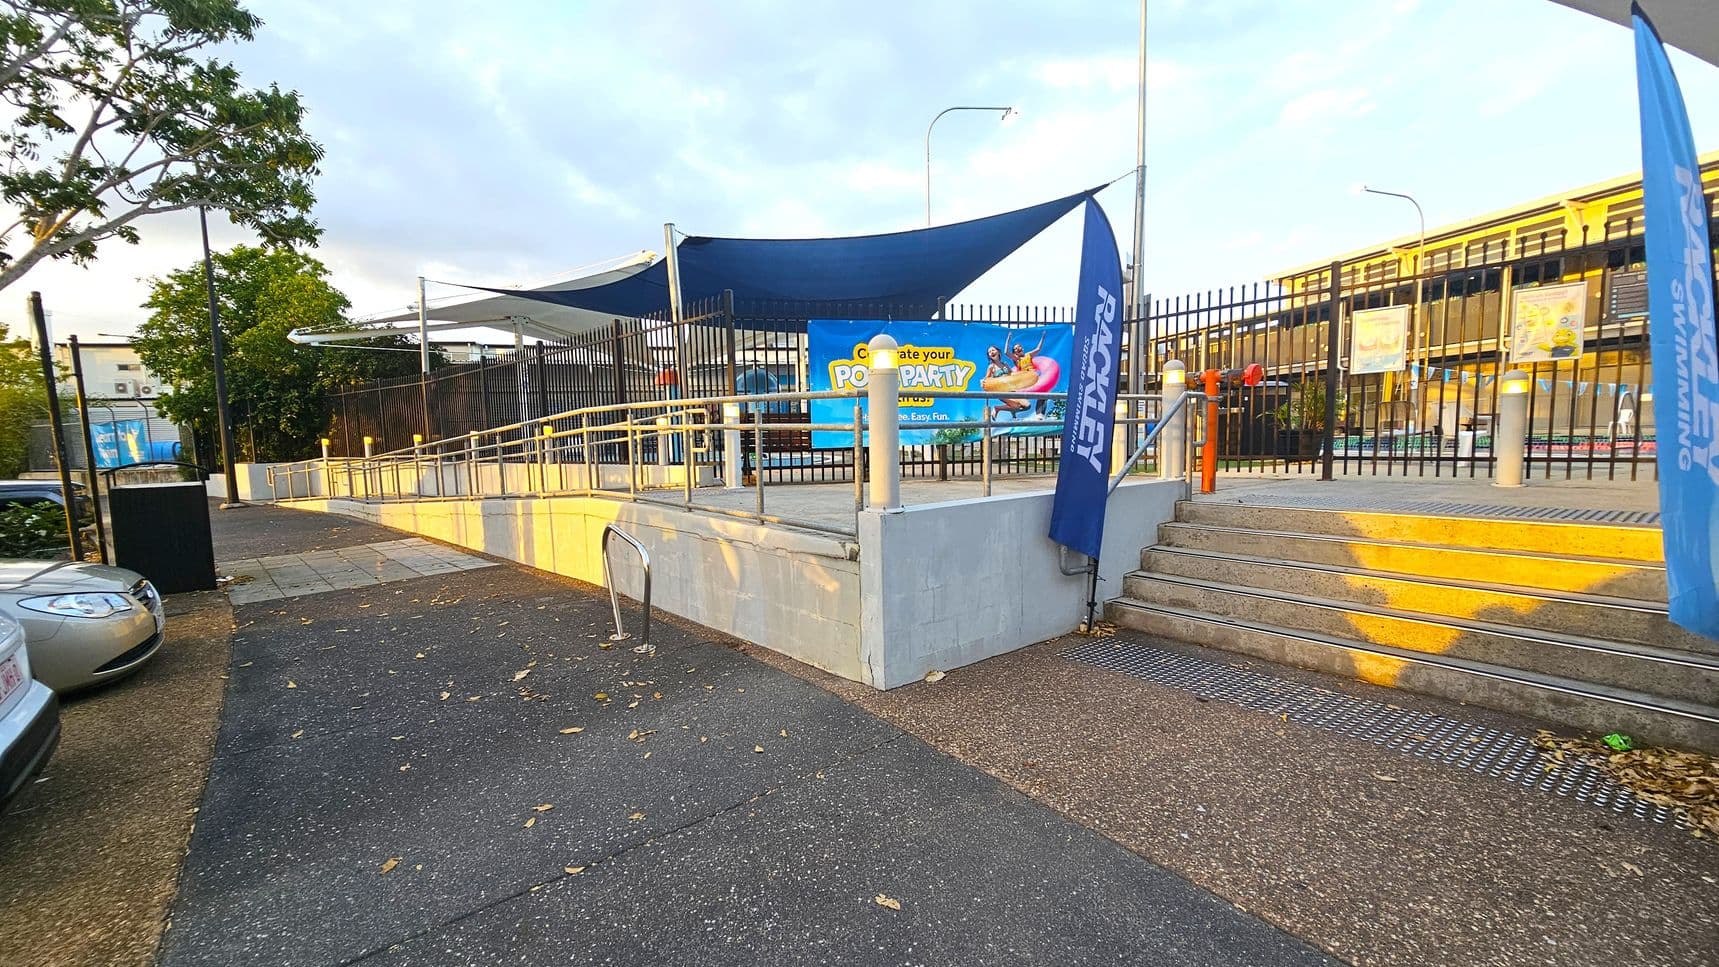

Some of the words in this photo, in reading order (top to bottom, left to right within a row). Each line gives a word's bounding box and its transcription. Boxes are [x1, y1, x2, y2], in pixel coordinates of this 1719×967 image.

[1674, 163, 1719, 487] RACKLEY
[899, 363, 971, 388] PARTY
[923, 350, 951, 362] your
[1077, 285, 1116, 474] RACKLEY
[1080, 336, 1090, 381] SQUAD
[1670, 278, 1692, 472] SWIMMING
[911, 412, 932, 422] Easy.
[932, 412, 950, 420] Fun.
[1070, 382, 1084, 453] SWIMMING
